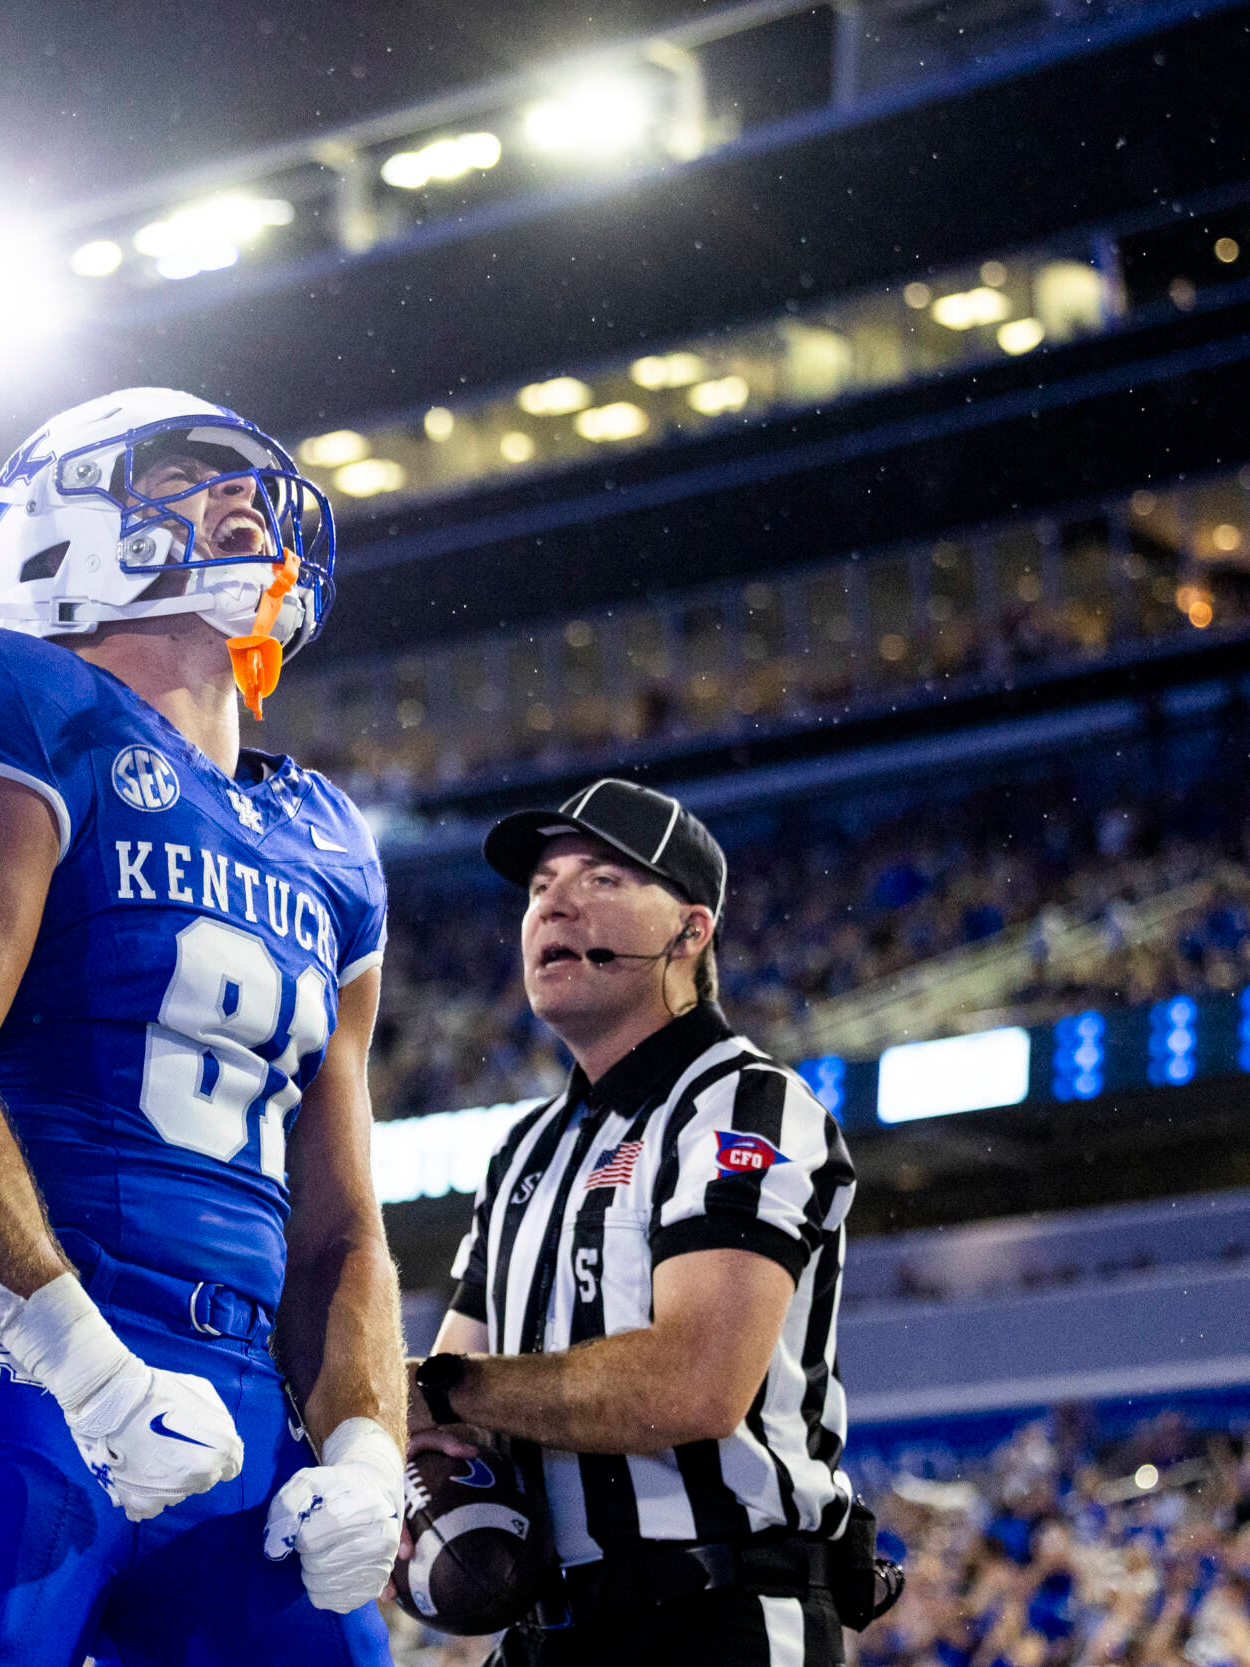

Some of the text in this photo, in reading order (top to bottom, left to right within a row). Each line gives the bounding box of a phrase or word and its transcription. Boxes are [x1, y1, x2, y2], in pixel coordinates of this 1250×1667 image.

[117, 749, 176, 806] SEC
[139, 915, 327, 1187] 81
[730, 1149, 763, 1169] CFO
[575, 1248, 598, 1302] S
